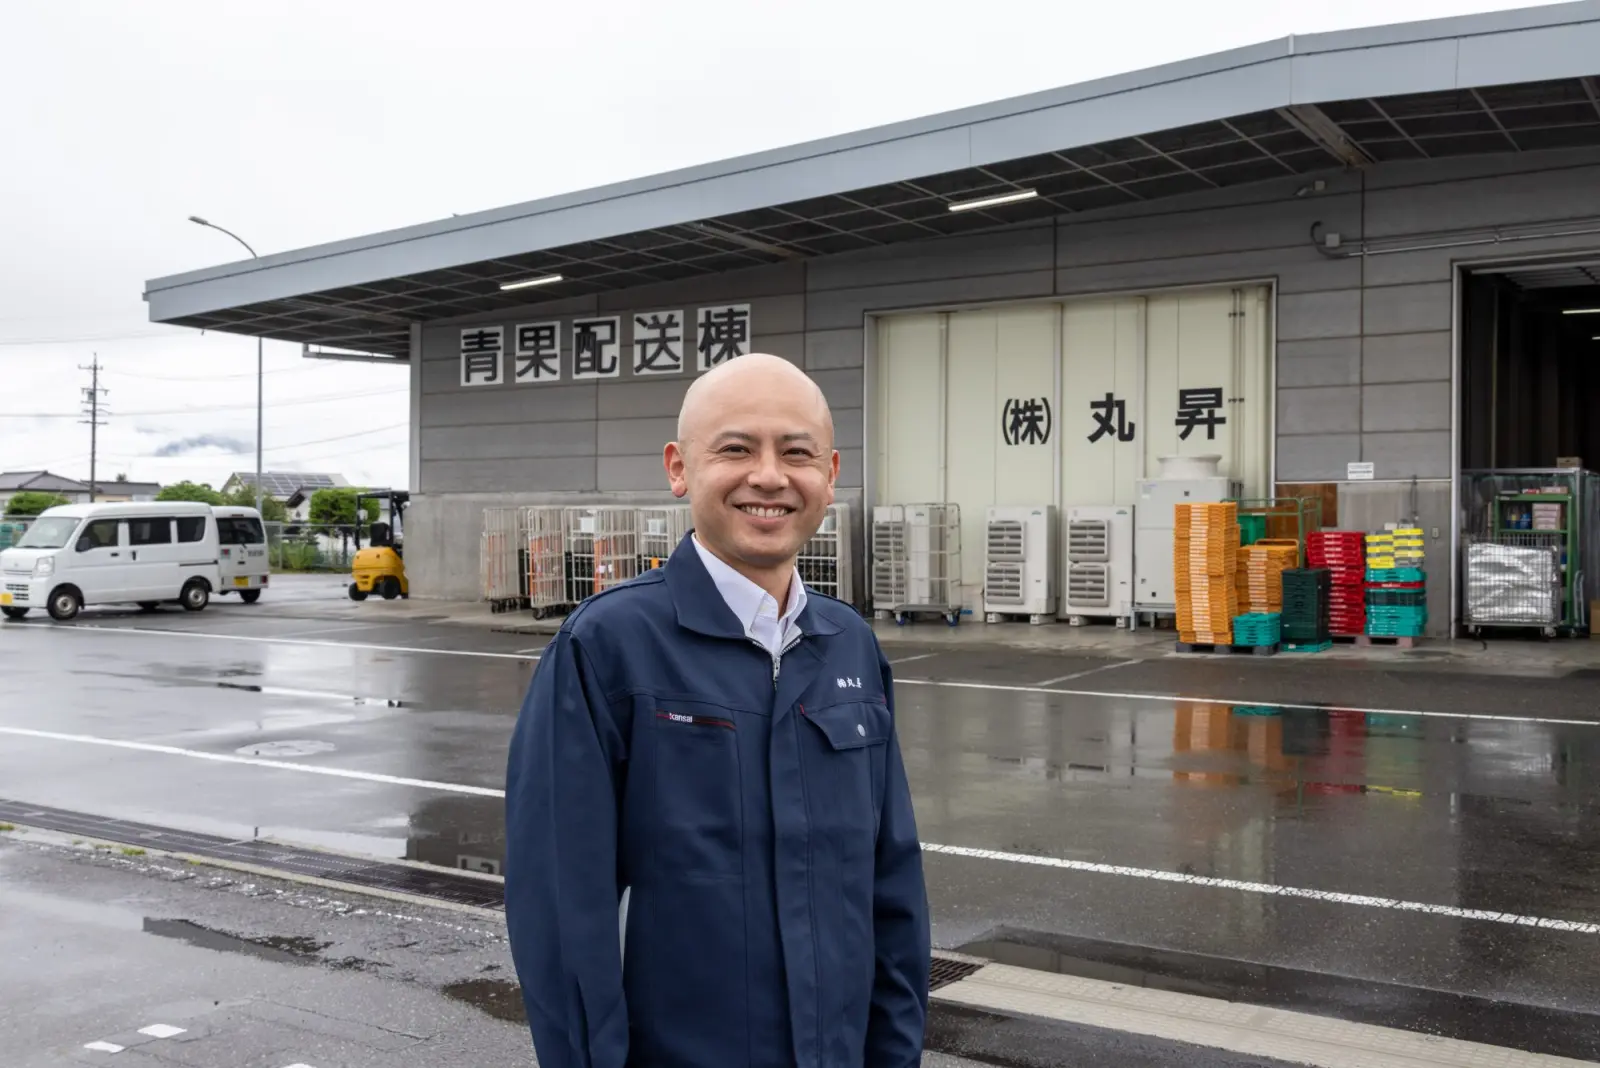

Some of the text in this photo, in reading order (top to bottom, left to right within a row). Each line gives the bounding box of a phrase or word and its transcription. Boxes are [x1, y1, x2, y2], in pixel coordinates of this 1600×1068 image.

[461, 307, 749, 383] 青果配送棟
